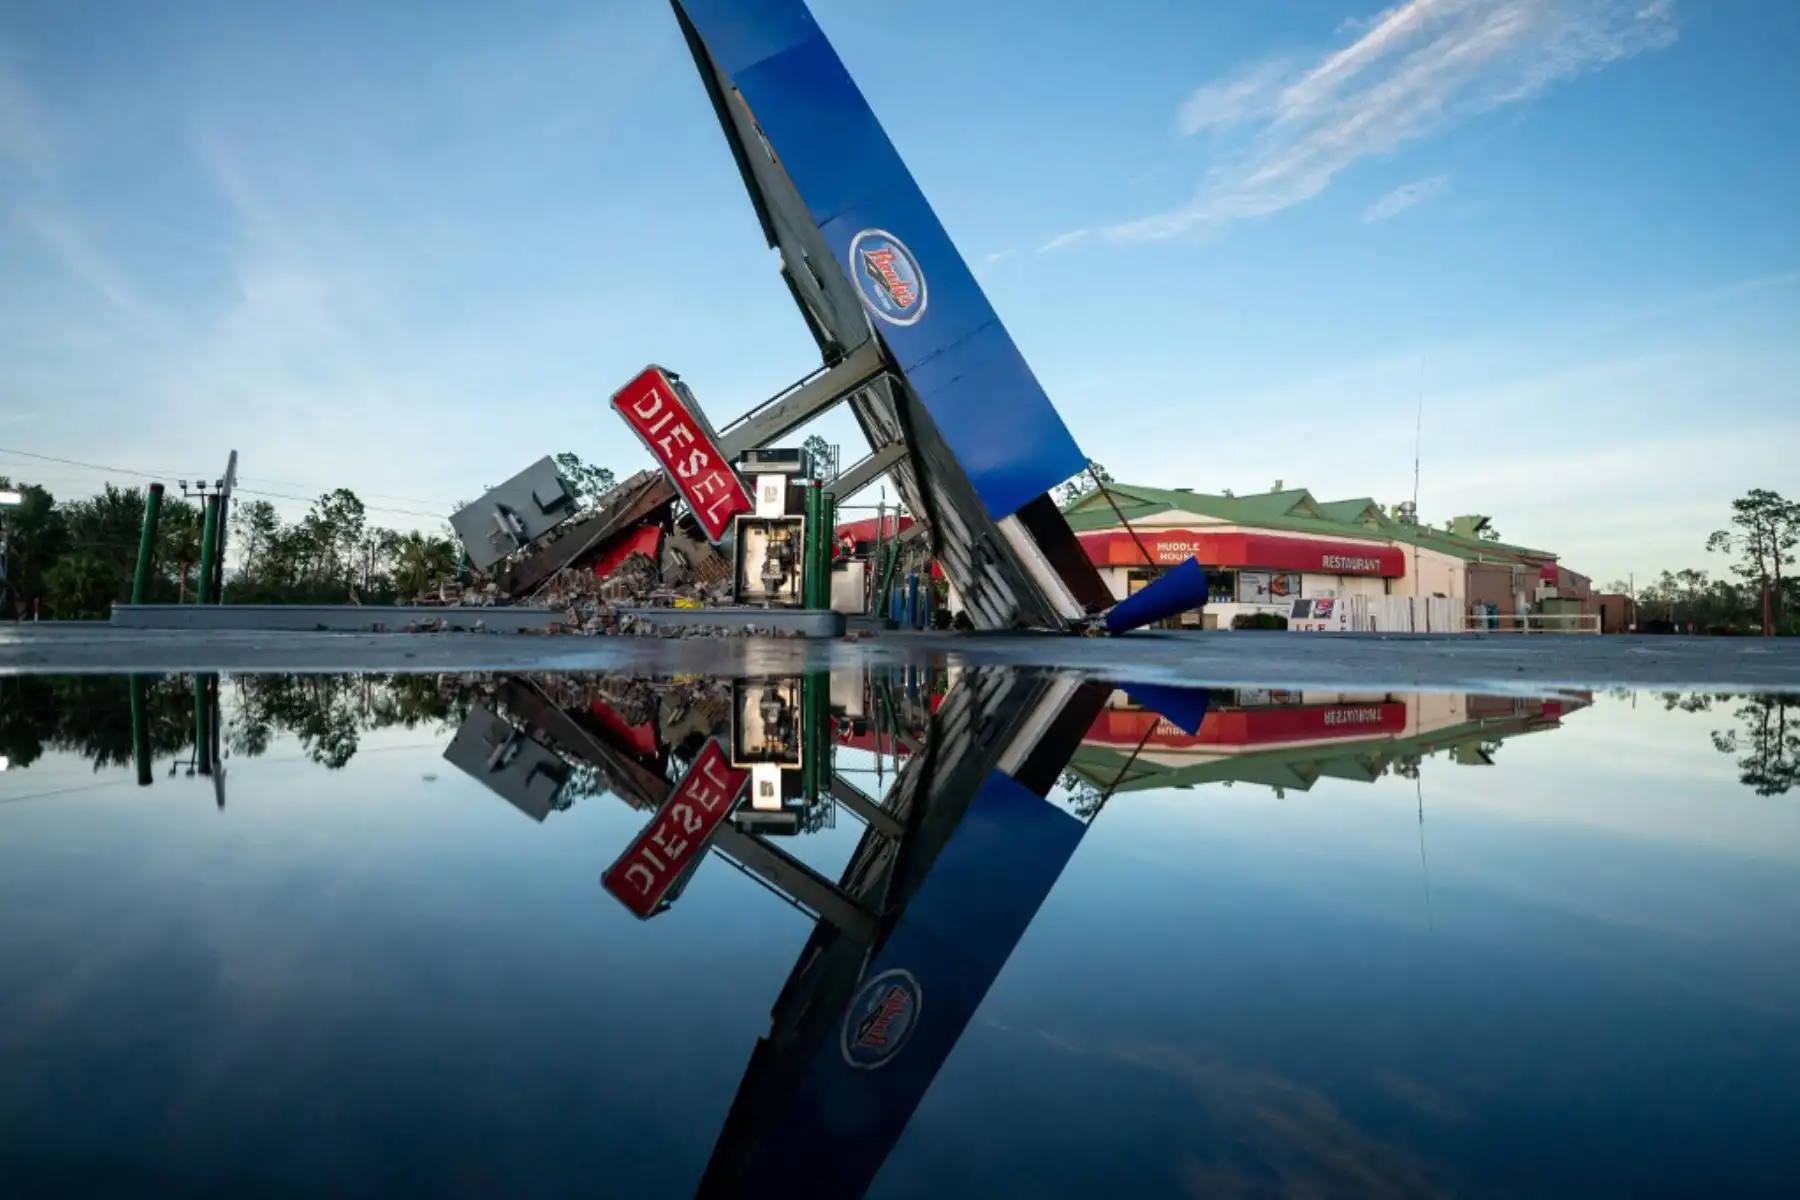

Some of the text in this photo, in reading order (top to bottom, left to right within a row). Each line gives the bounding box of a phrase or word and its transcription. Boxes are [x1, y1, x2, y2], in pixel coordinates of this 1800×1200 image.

[633, 388, 730, 525] DIESEL
[1156, 541, 1200, 551] HUDDLE
[1322, 555, 1380, 572] RESTAURANT
